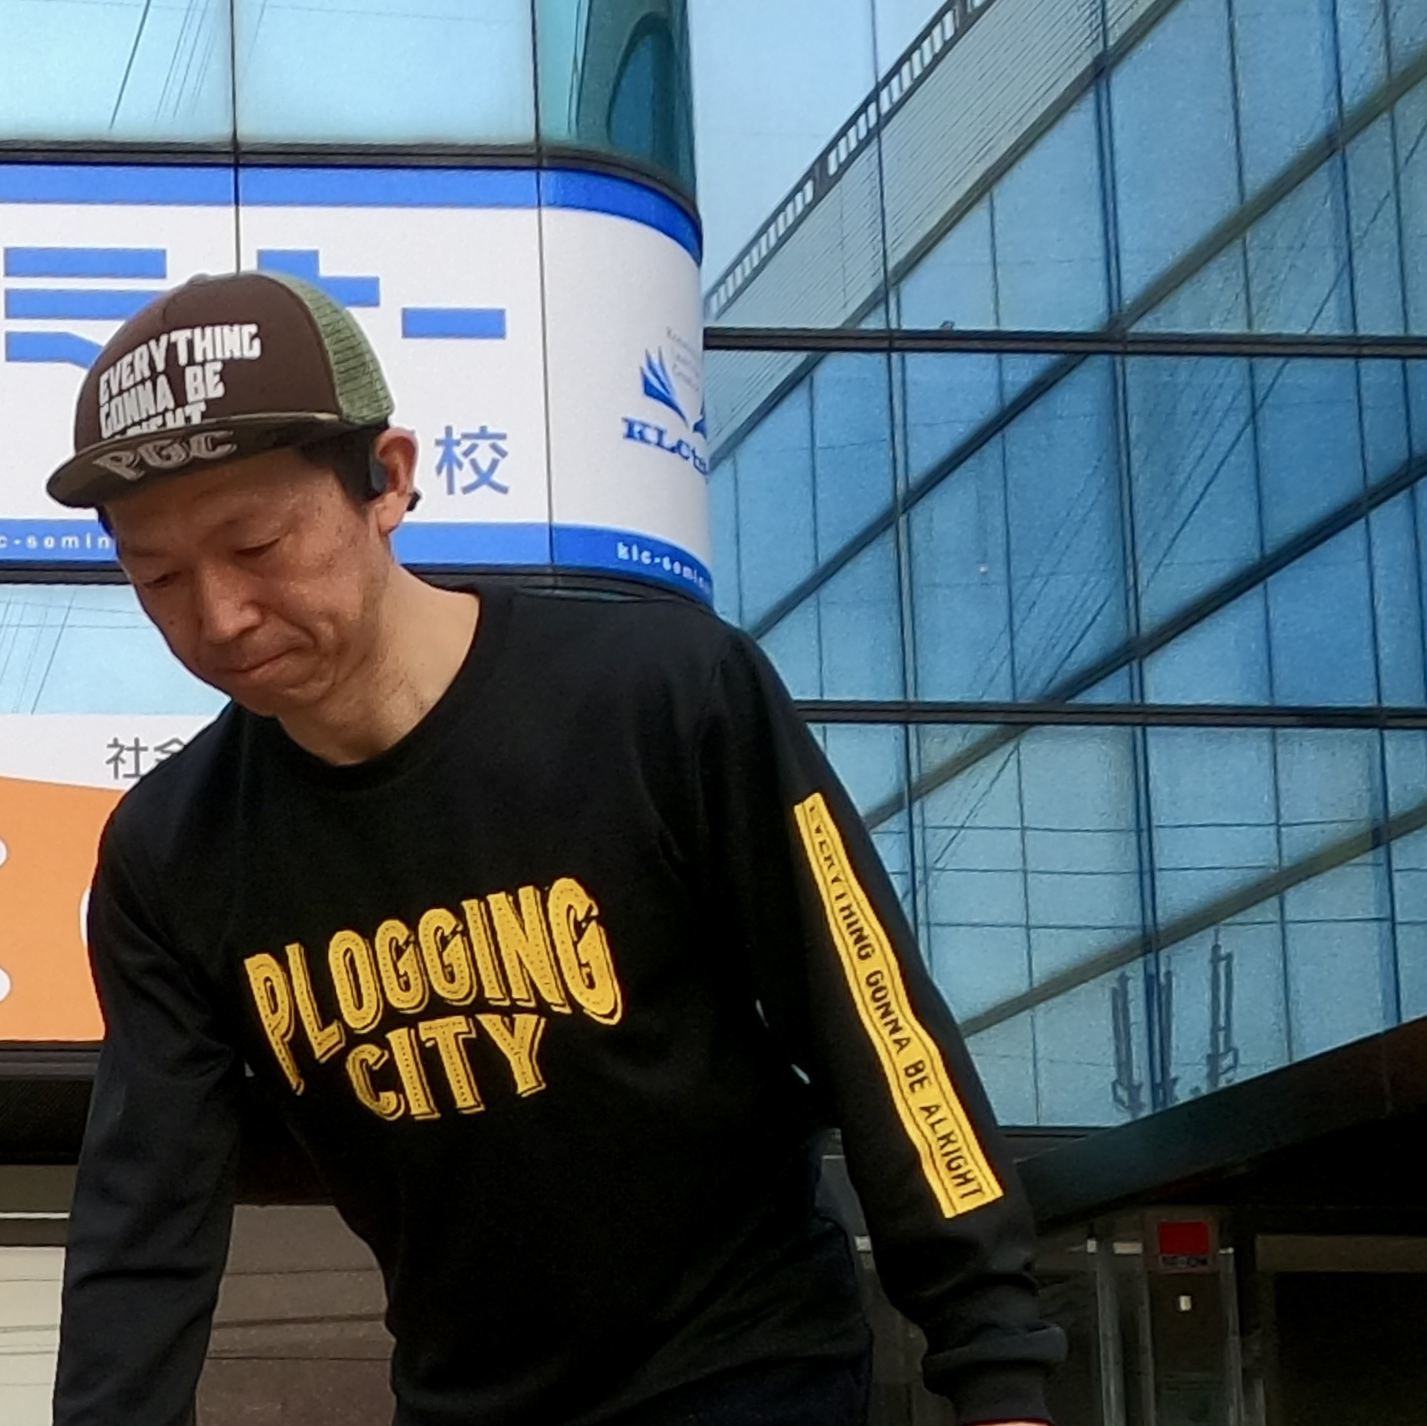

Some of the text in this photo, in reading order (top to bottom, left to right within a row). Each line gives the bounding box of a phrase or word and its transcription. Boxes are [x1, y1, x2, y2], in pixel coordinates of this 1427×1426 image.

[98, 322, 262, 408] EVERYTHING
[99, 373, 176, 440] GONNA
[184, 361, 226, 404] BE
[243, 877, 623, 1096] PLOGGING
[346, 1012, 547, 1122] CITY
[864, 969, 910, 1054] GONNA
[903, 1058, 933, 1095] BE
[919, 1102, 986, 1200] ALRIGHT
